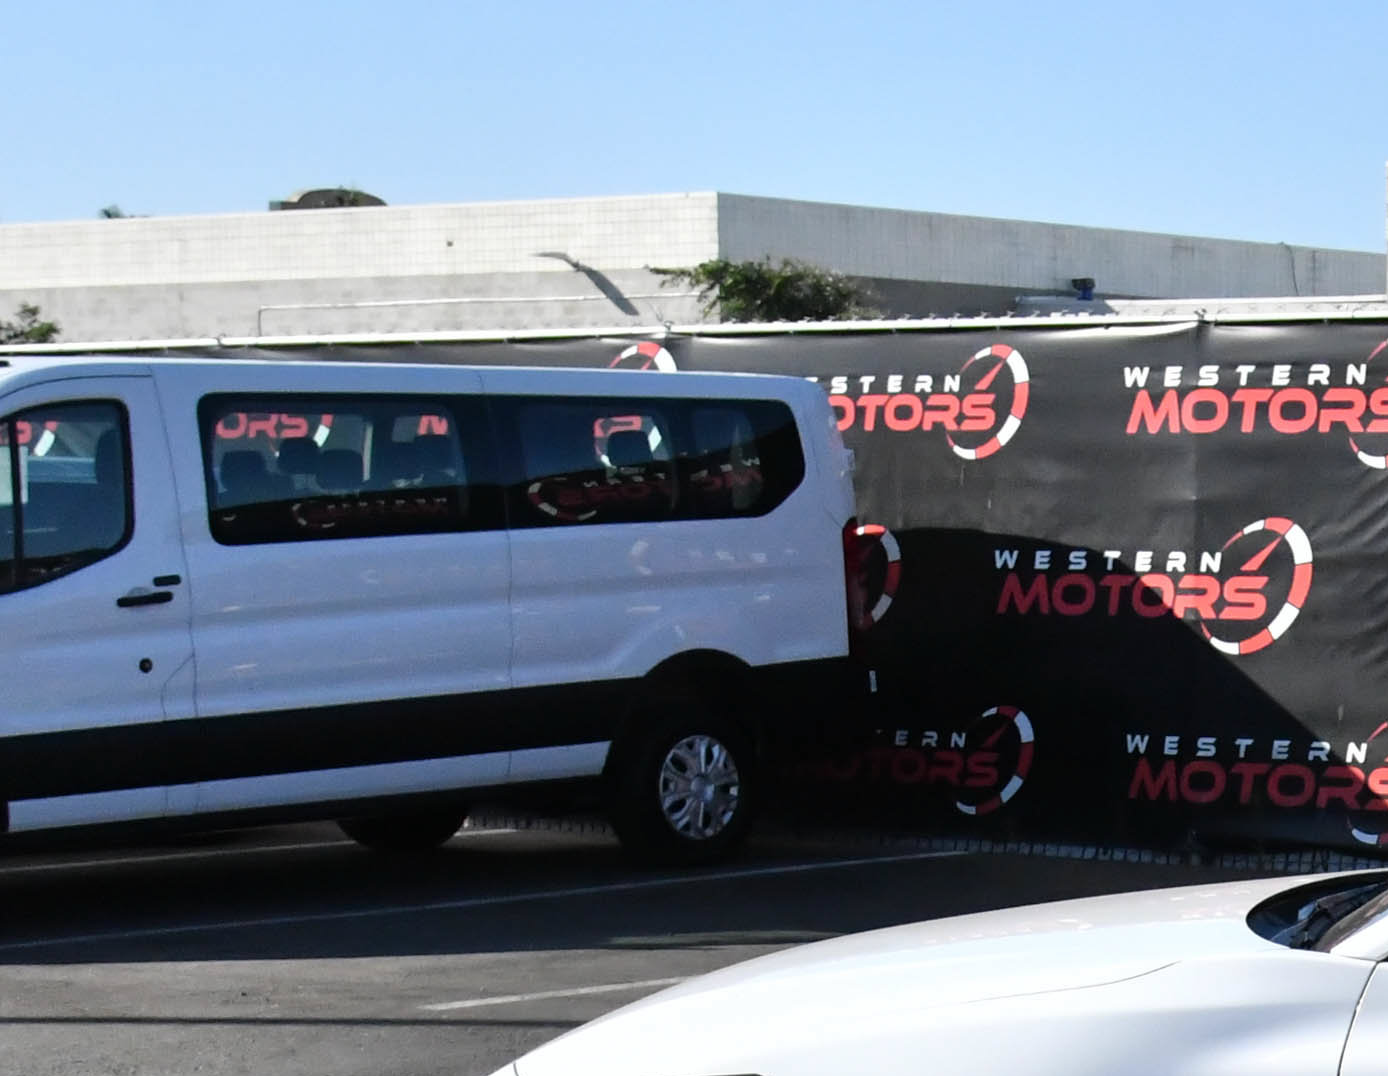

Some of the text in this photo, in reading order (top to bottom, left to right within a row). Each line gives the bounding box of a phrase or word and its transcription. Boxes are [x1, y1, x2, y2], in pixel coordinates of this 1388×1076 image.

[805, 375, 960, 394] STERN
[1123, 364, 1367, 388] WESTERN
[828, 393, 996, 431] OTORS
[995, 550, 1222, 573] WESTERN
[996, 572, 1269, 620] MOTORS
[1126, 733, 1367, 764] WESTERN
